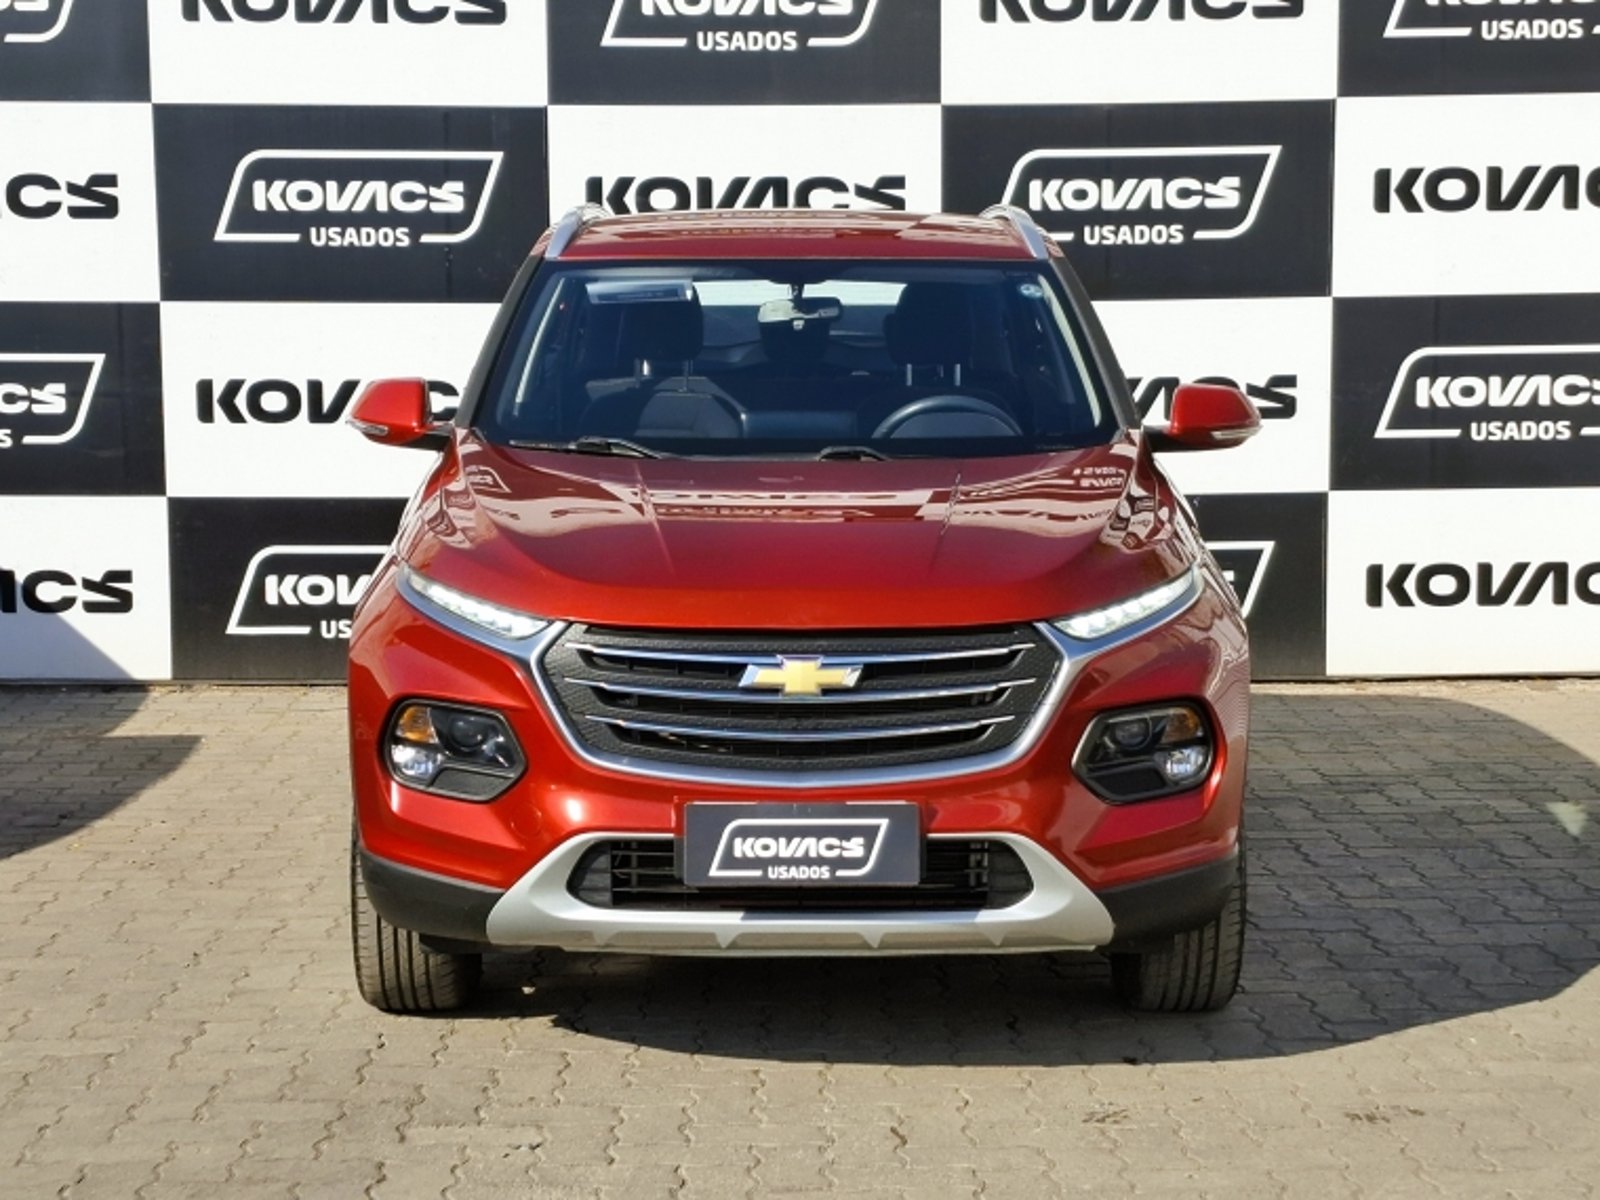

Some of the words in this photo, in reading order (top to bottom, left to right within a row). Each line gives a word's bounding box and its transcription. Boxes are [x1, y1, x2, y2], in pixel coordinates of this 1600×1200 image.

[697, 31, 798, 51] USADOS
[1481, 18, 1584, 41] USADOS
[253, 180, 465, 213] KOVACS
[585, 175, 906, 214] KOVACS
[1029, 176, 1241, 211] KOVACS
[1374, 165, 1600, 213] KOVA
[310, 227, 411, 248] USADOS
[1084, 225, 1184, 245] USADOS
[1416, 374, 1600, 408] KOVAC
[1470, 421, 1572, 441] USADOS
[732, 836, 865, 859] KOVACS
[768, 864, 831, 880] USADOS
